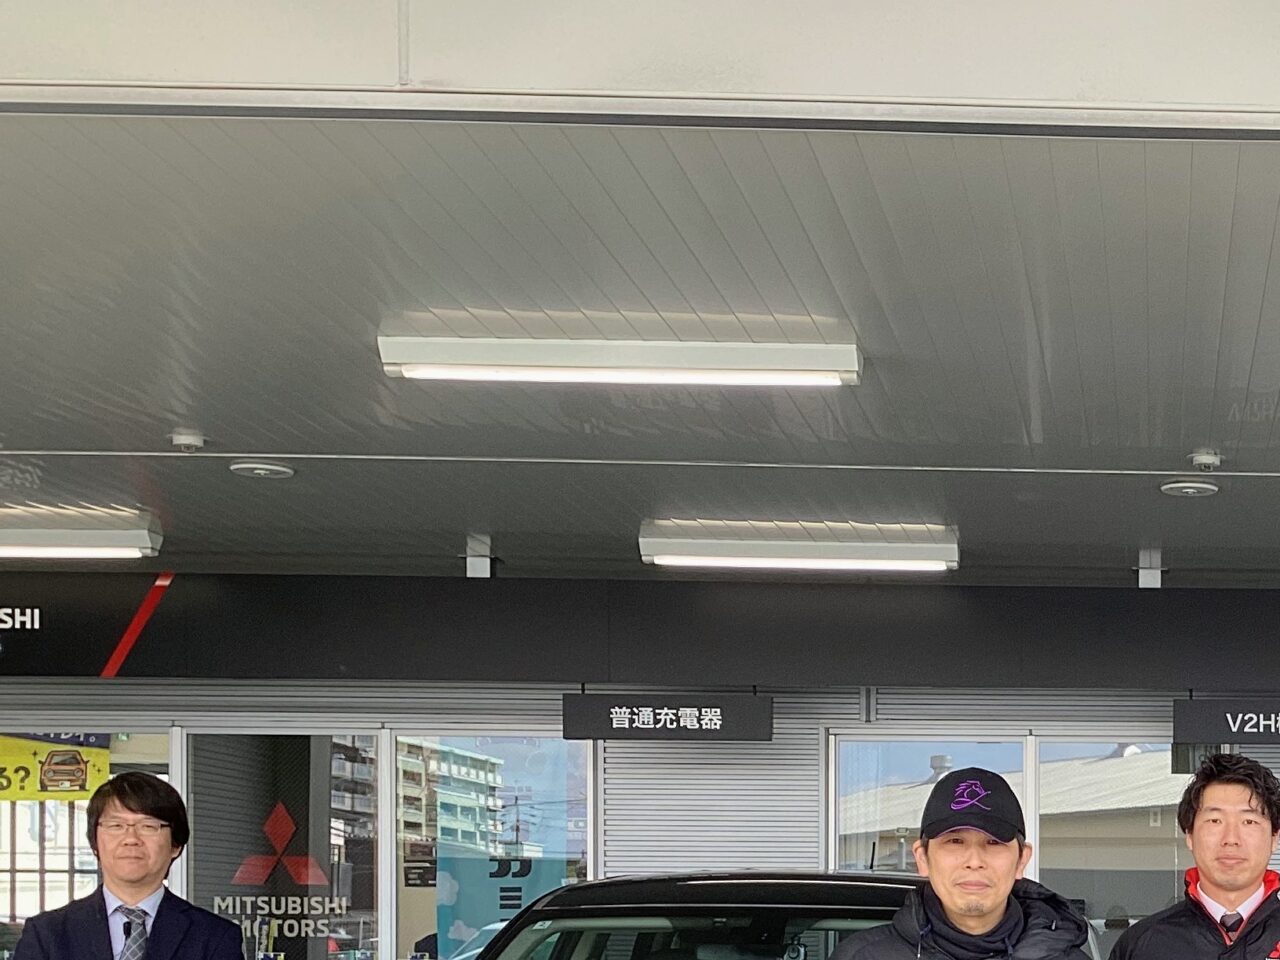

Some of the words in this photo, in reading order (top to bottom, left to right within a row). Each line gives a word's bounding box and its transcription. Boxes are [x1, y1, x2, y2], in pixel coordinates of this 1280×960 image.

[609, 705, 723, 731] 普通充電器
[213, 896, 348, 915] MITSUBISHI
